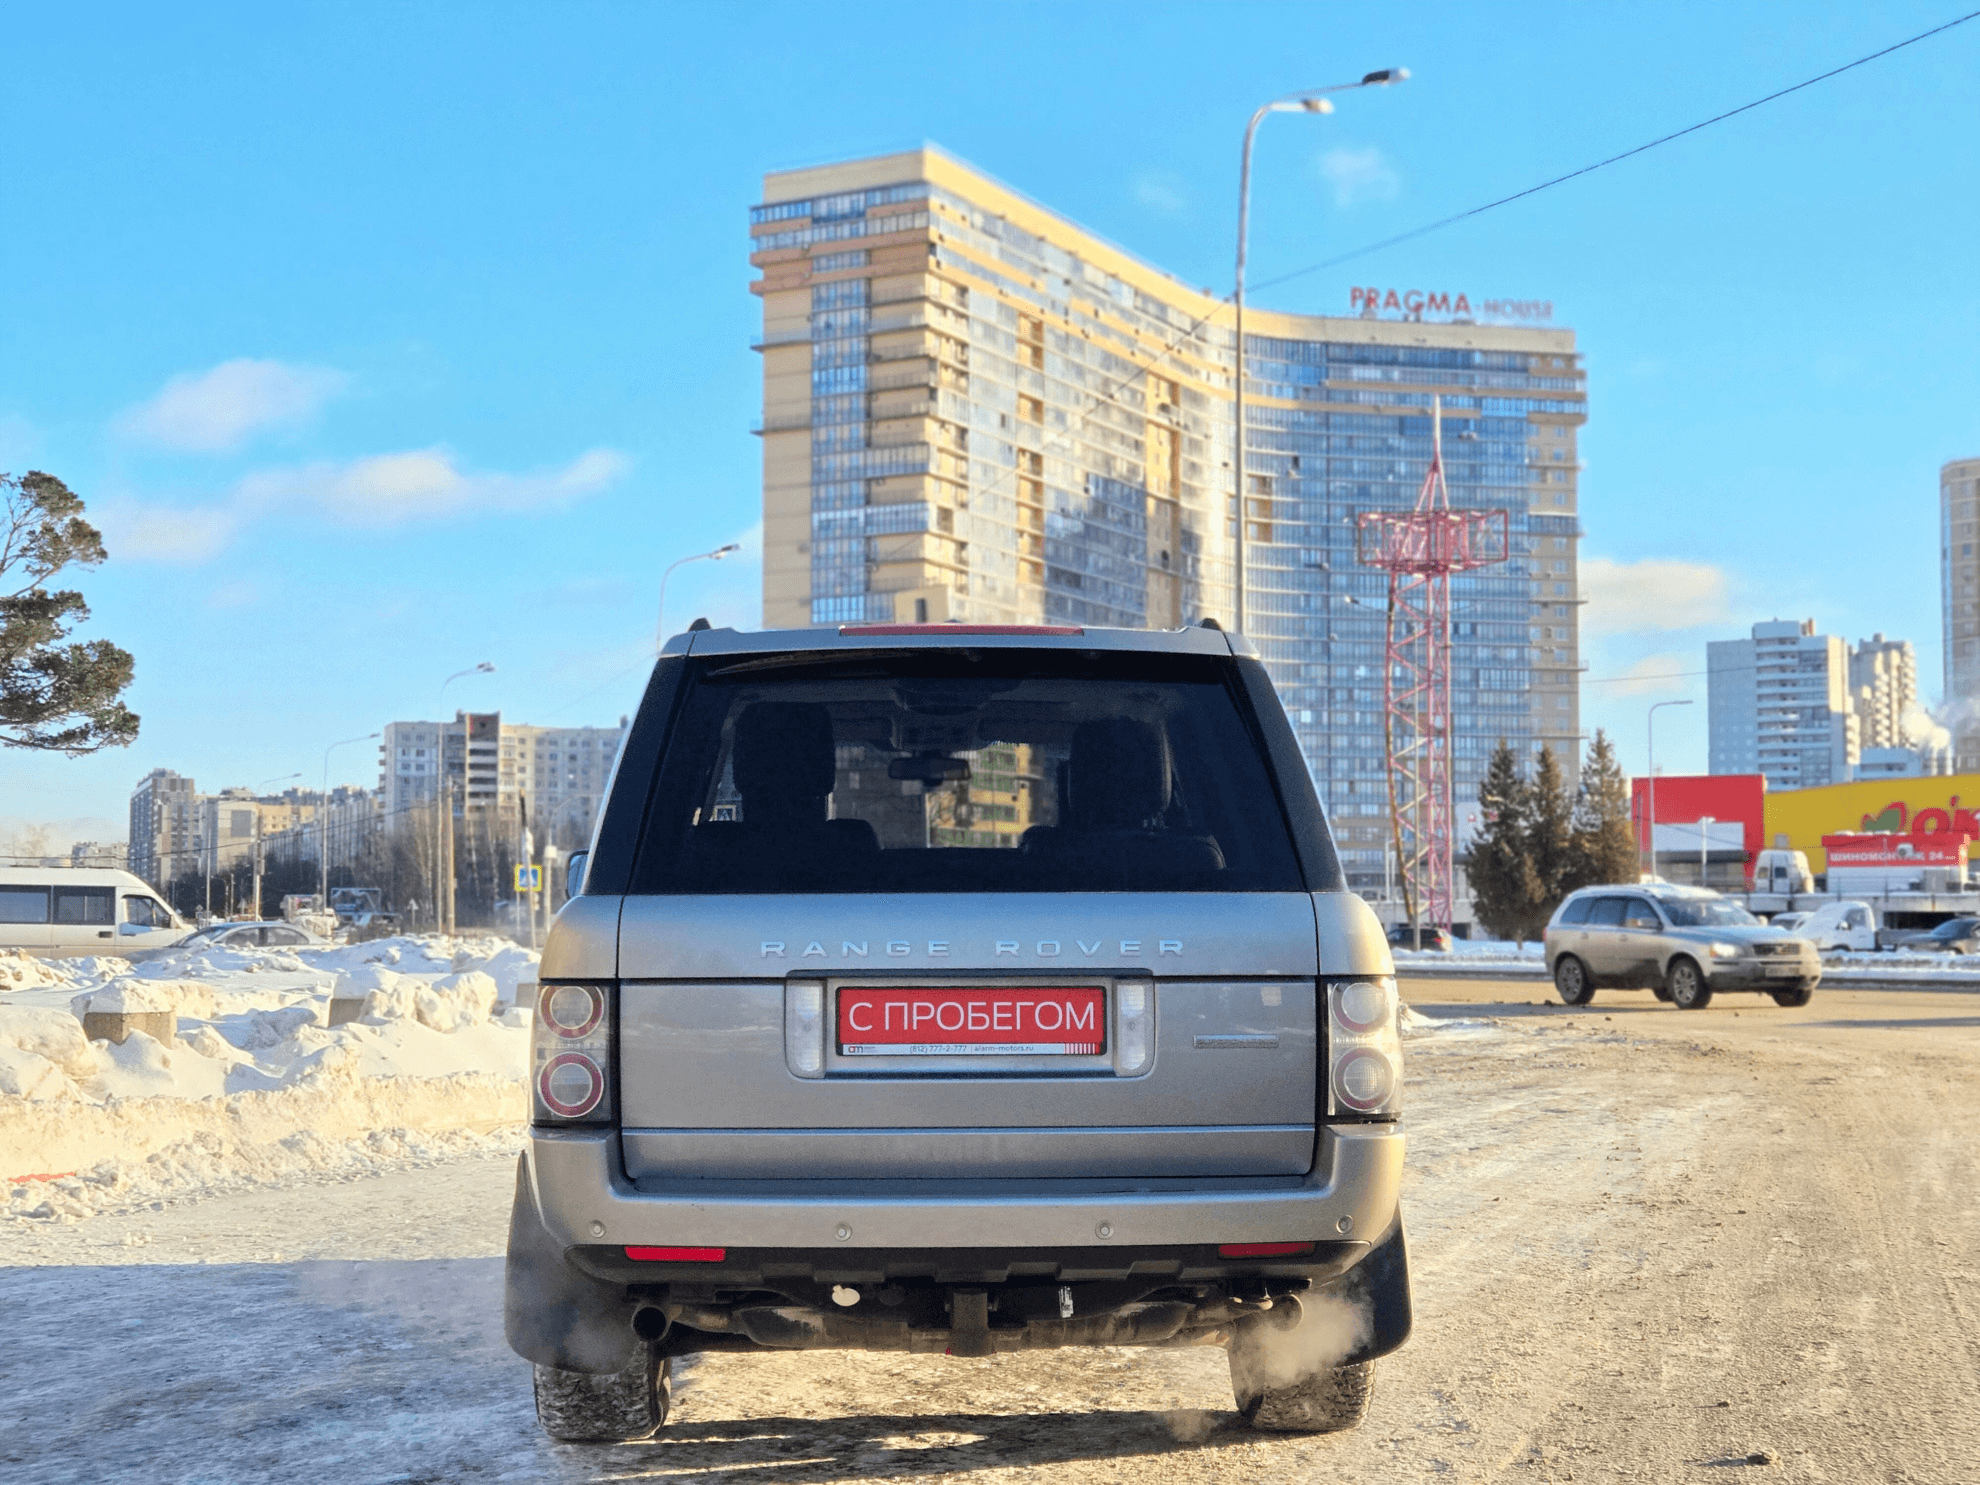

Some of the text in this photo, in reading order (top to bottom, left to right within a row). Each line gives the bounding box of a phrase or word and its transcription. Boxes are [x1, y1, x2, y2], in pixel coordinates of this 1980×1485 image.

[1349, 285, 1472, 315] PRAGMA
[761, 939, 1185, 958] RANGE ROVER
[849, 1001, 1095, 1031] С ПРОБЕГОМ
[909, 1044, 1034, 1055] (812) 777-2-777 alarm-motors.ru
